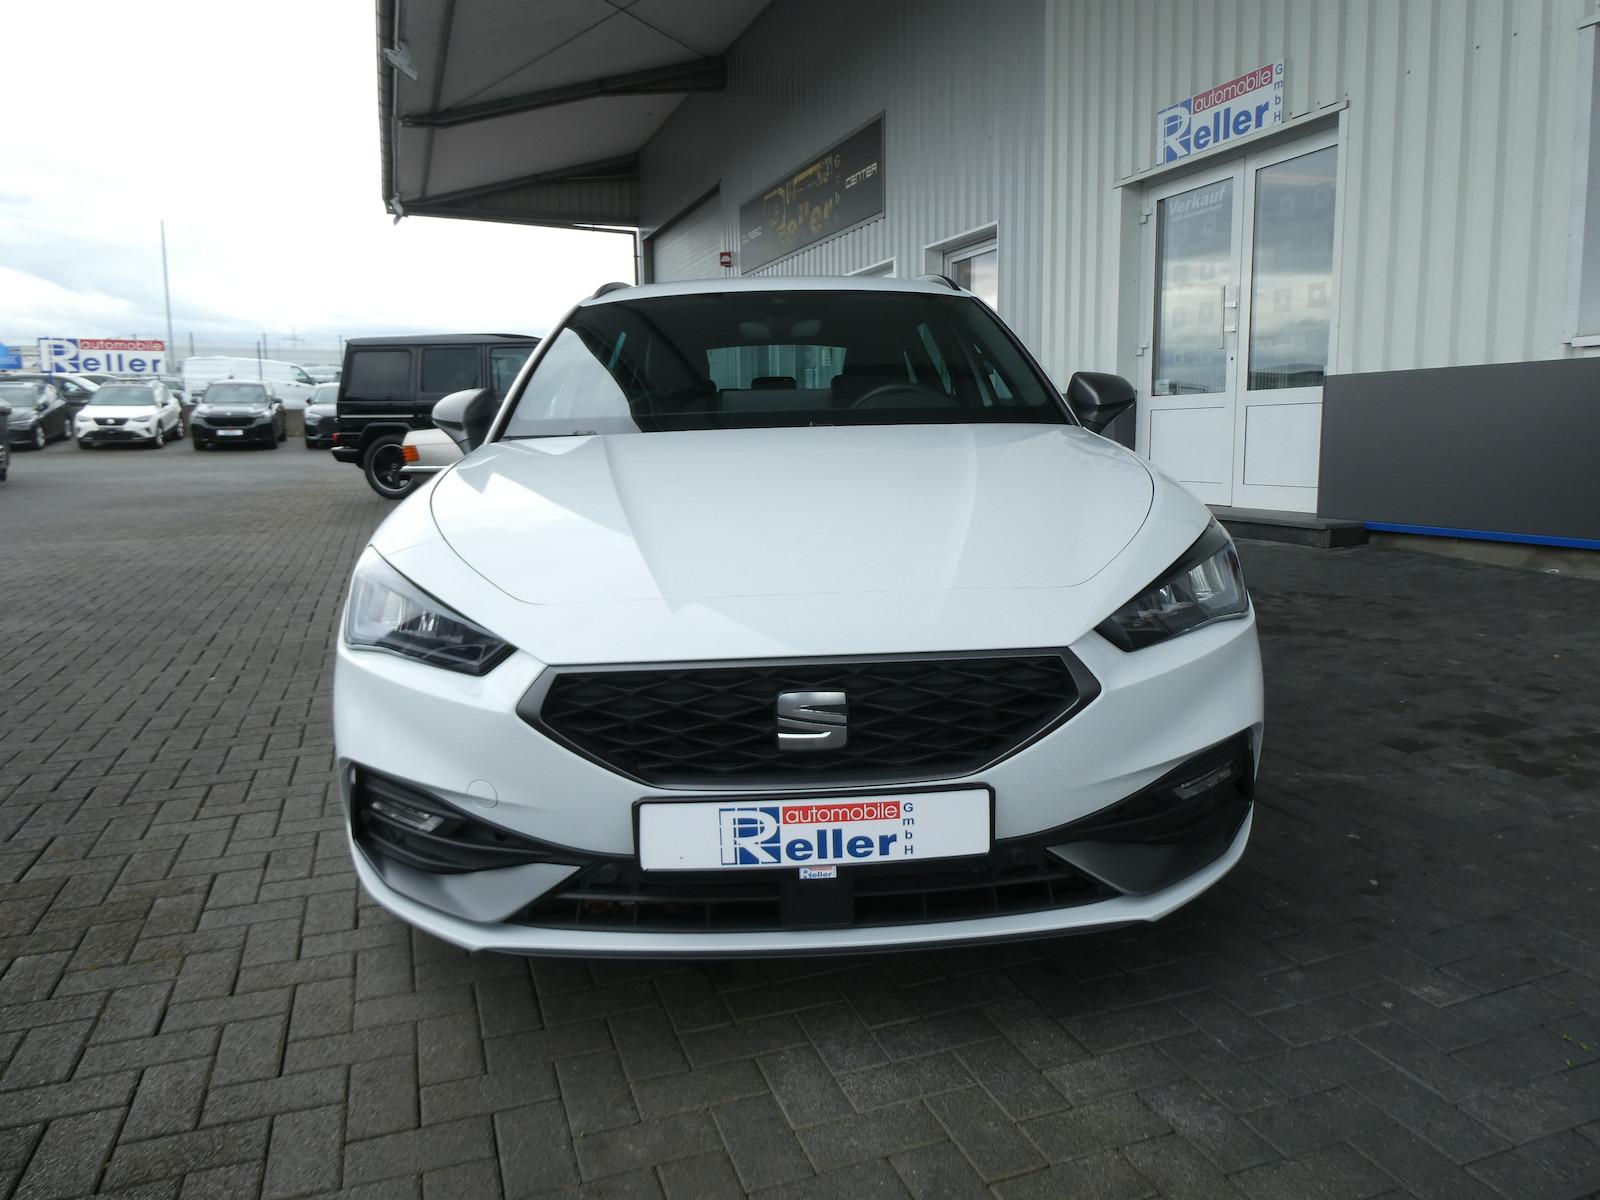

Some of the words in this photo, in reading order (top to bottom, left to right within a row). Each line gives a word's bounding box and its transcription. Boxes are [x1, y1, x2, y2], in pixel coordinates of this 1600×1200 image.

[1194, 70, 1272, 112] automobile
[1156, 98, 1270, 166] Reller
[845, 162, 878, 189] CENTER
[1168, 185, 1227, 216] Verkauf
[39, 338, 161, 373] Reller
[81, 341, 161, 350] automobile
[785, 803, 898, 823] automobile
[719, 807, 897, 864] Reller
